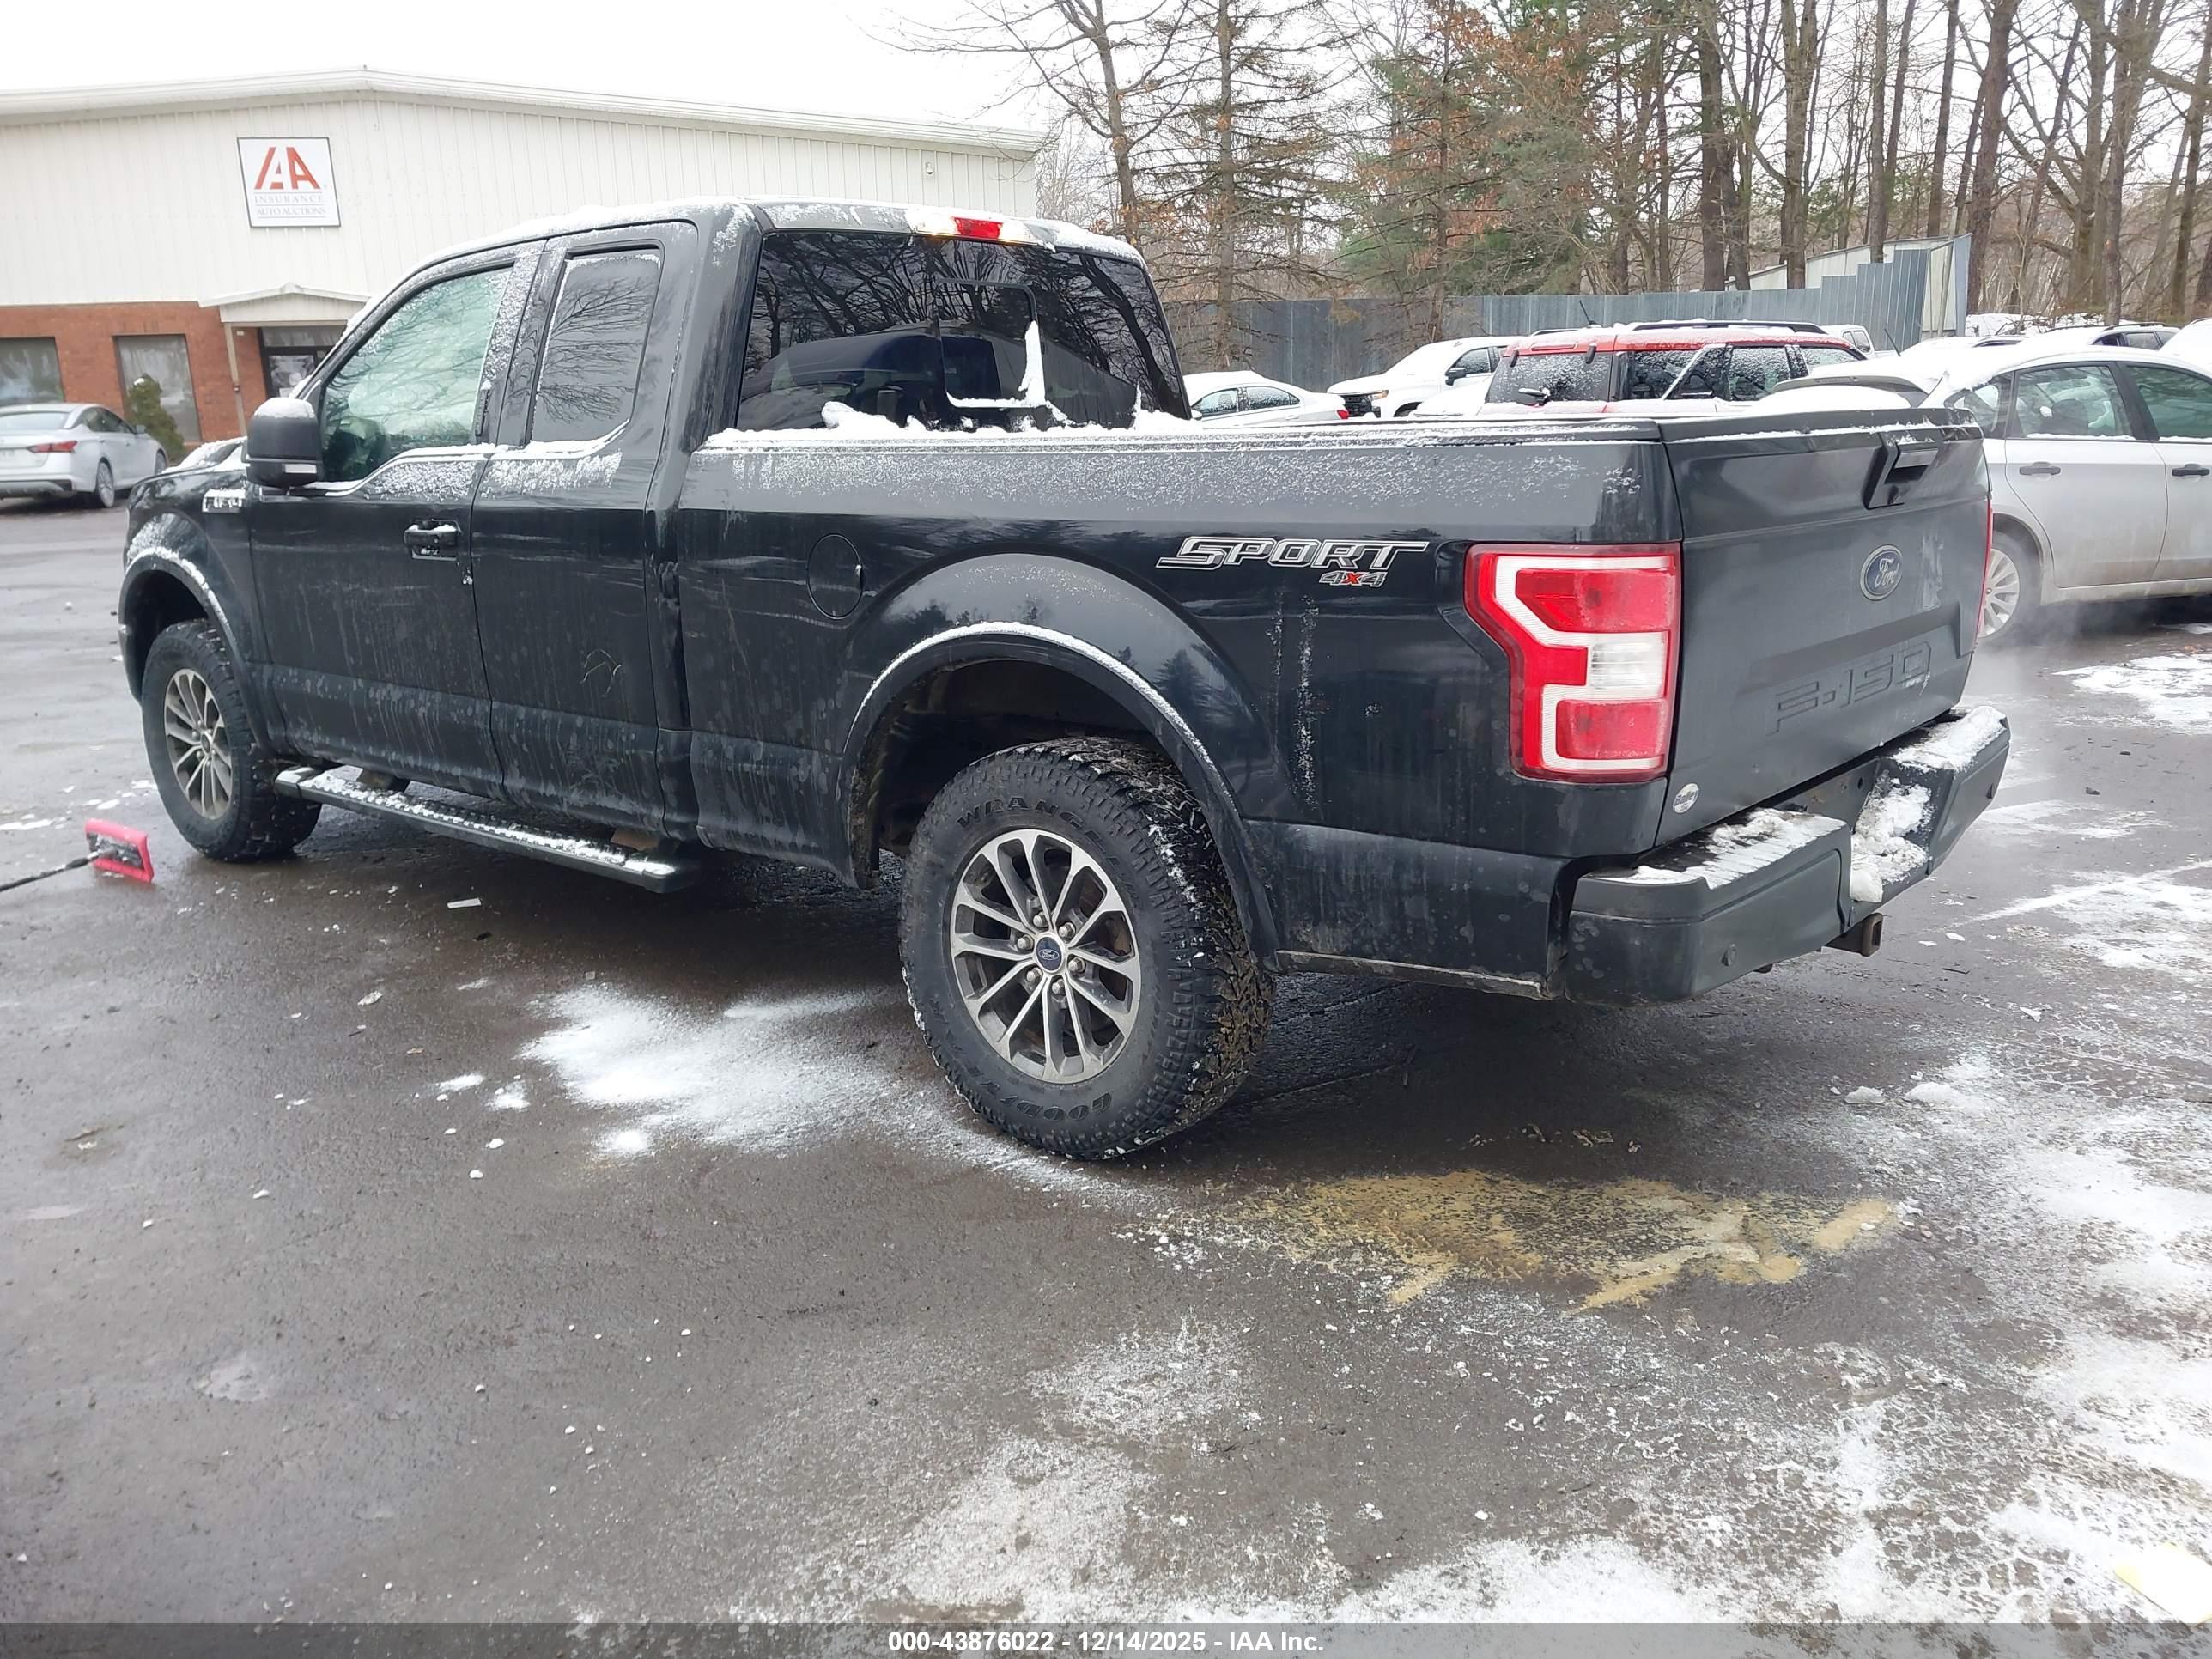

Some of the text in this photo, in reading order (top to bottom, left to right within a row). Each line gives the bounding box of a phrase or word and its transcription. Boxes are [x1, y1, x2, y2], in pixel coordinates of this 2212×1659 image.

[254, 146, 321, 190] IAA
[254, 194, 324, 204] INSURANCE
[282, 206, 326, 215] AUCTIONS
[1155, 536, 1430, 571] SPORT
[1875, 557, 1899, 587] Ford
[1765, 640, 1932, 737] F-150
